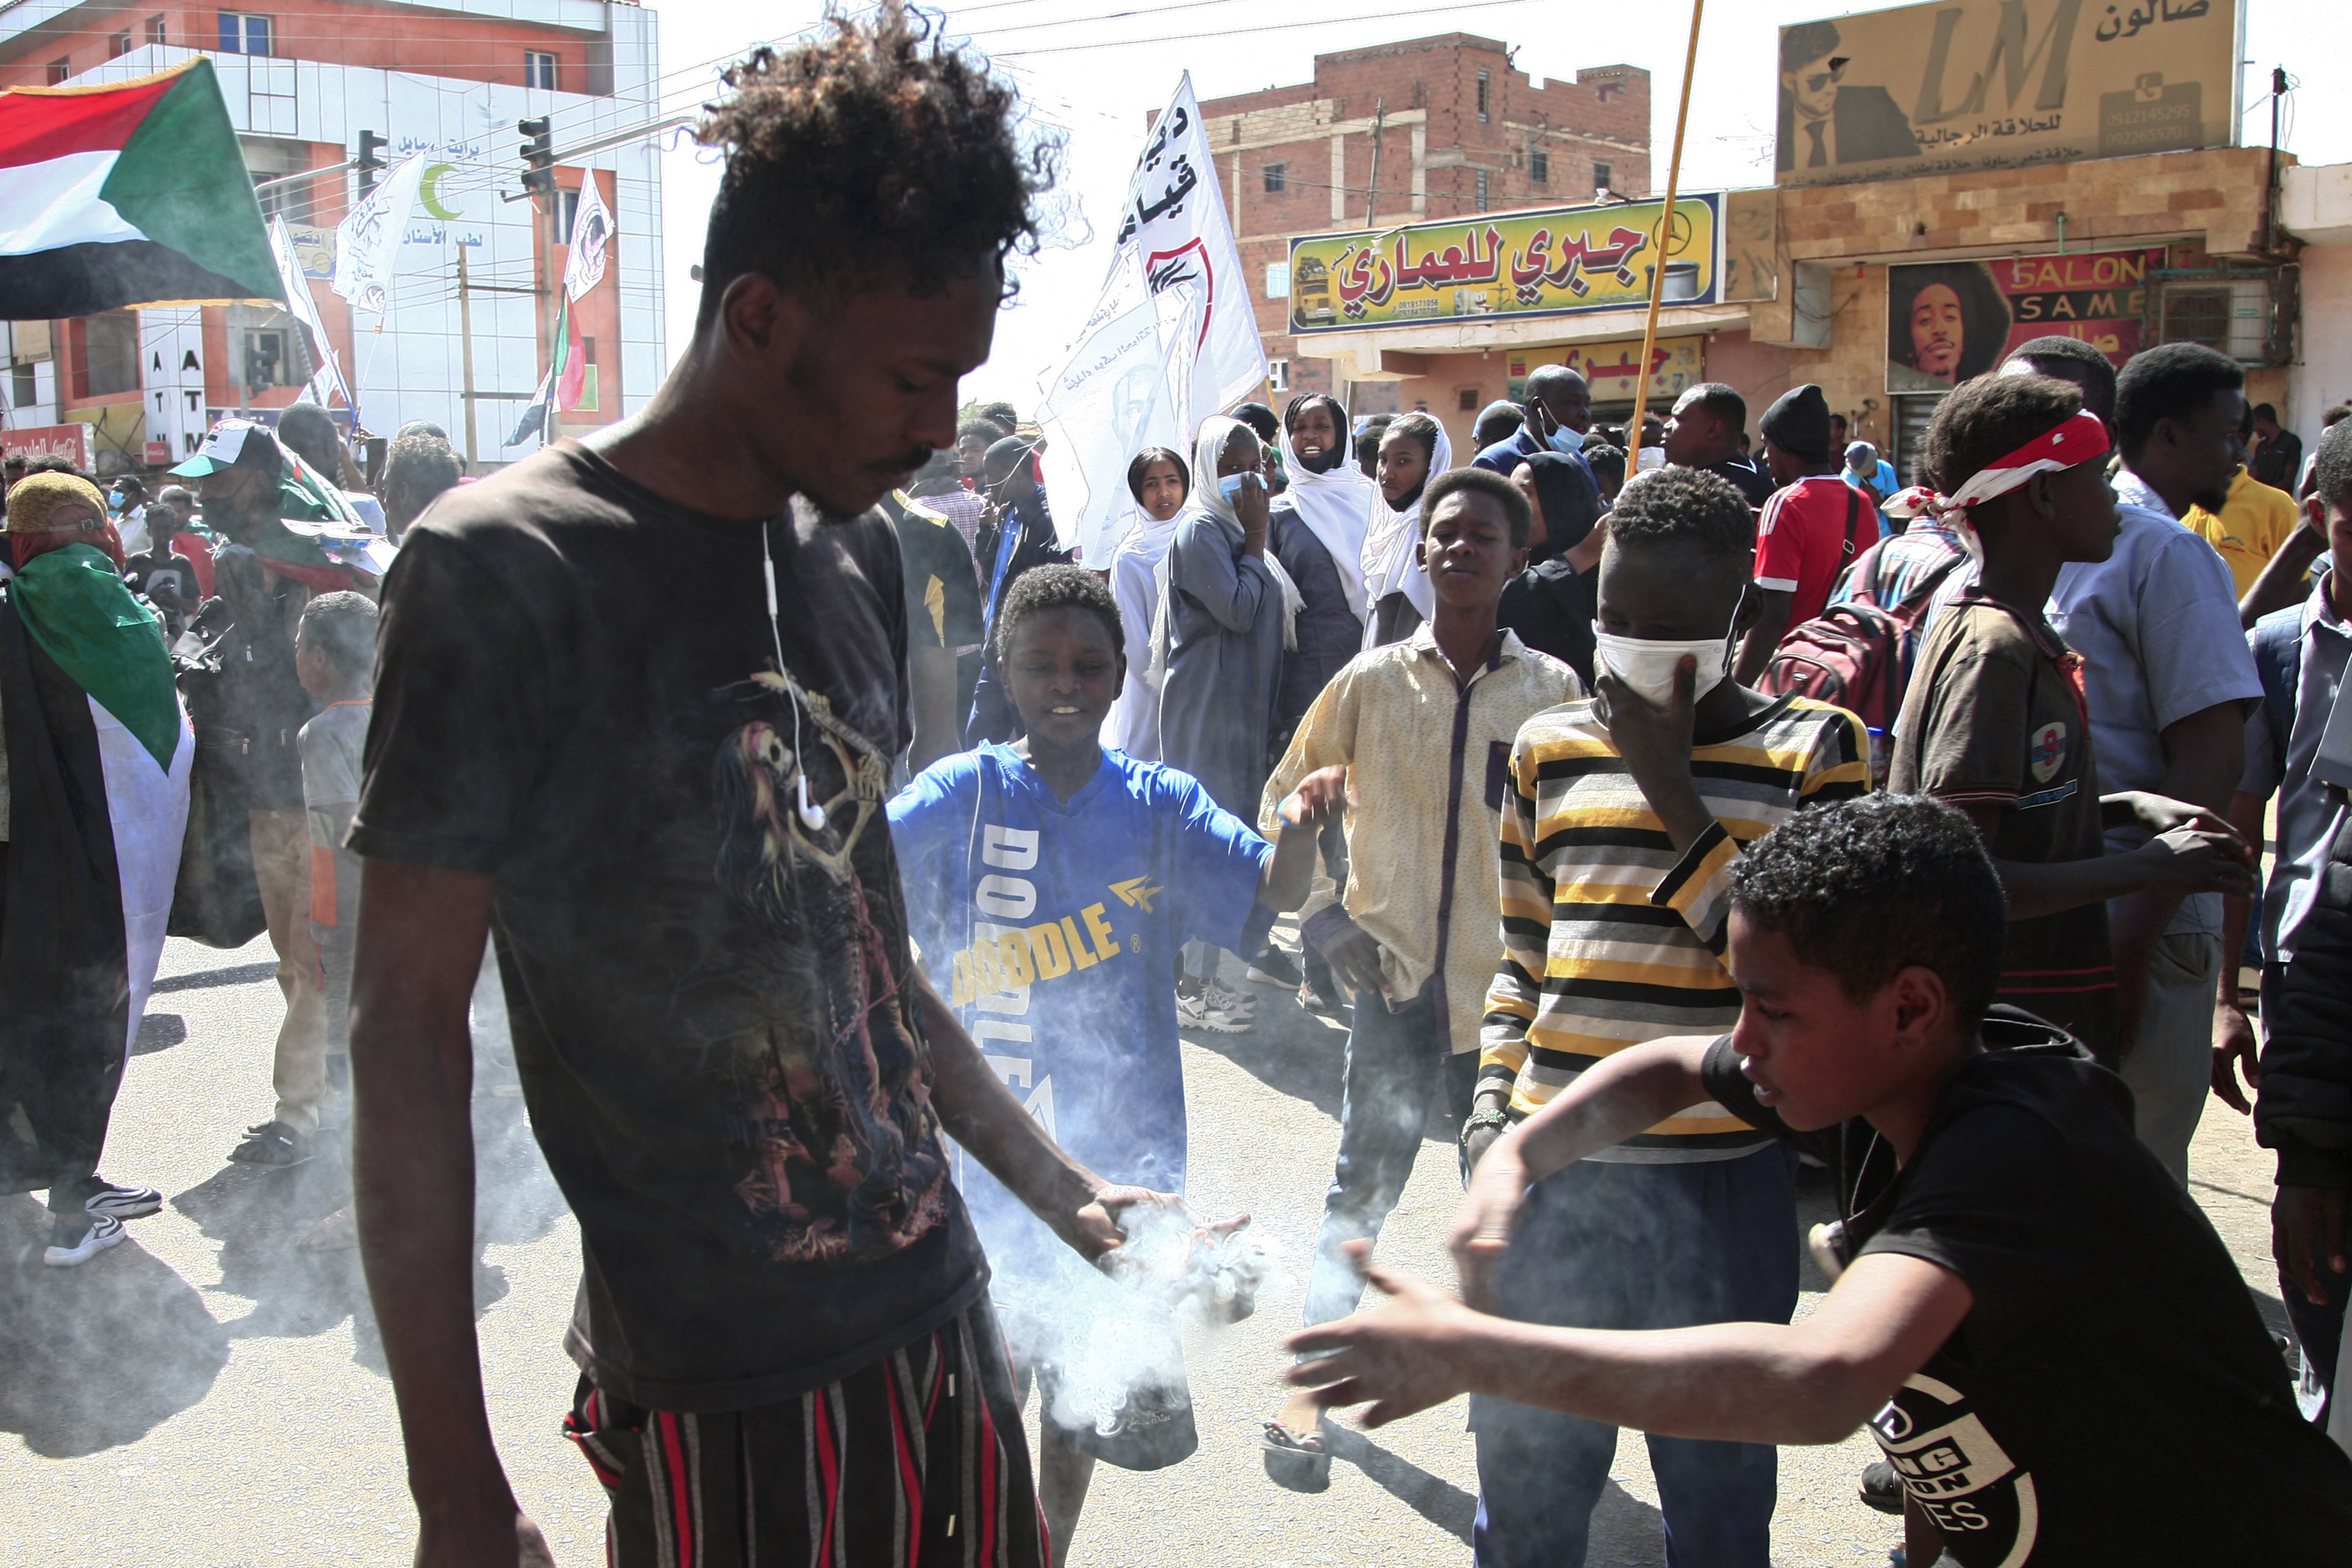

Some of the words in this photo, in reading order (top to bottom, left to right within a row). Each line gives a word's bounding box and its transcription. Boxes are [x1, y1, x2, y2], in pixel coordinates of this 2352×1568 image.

[2096, 0, 2210, 42] صالون
[1912, 0, 2082, 126] LM
[1991, 114, 2062, 137] للحلاقة
[2106, 103, 2192, 127] 0912145295
[1915, 124, 1988, 147] الرجالية
[2106, 126, 2190, 147] 0922655701
[2019, 150, 2043, 166] شعر
[2045, 147, 2083, 160] حلاقة
[1937, 160, 1972, 172] حلاقة
[1511, 225, 1648, 305] جبري
[2011, 255, 2145, 290] SALON
[181, 350, 206, 454] ATM
